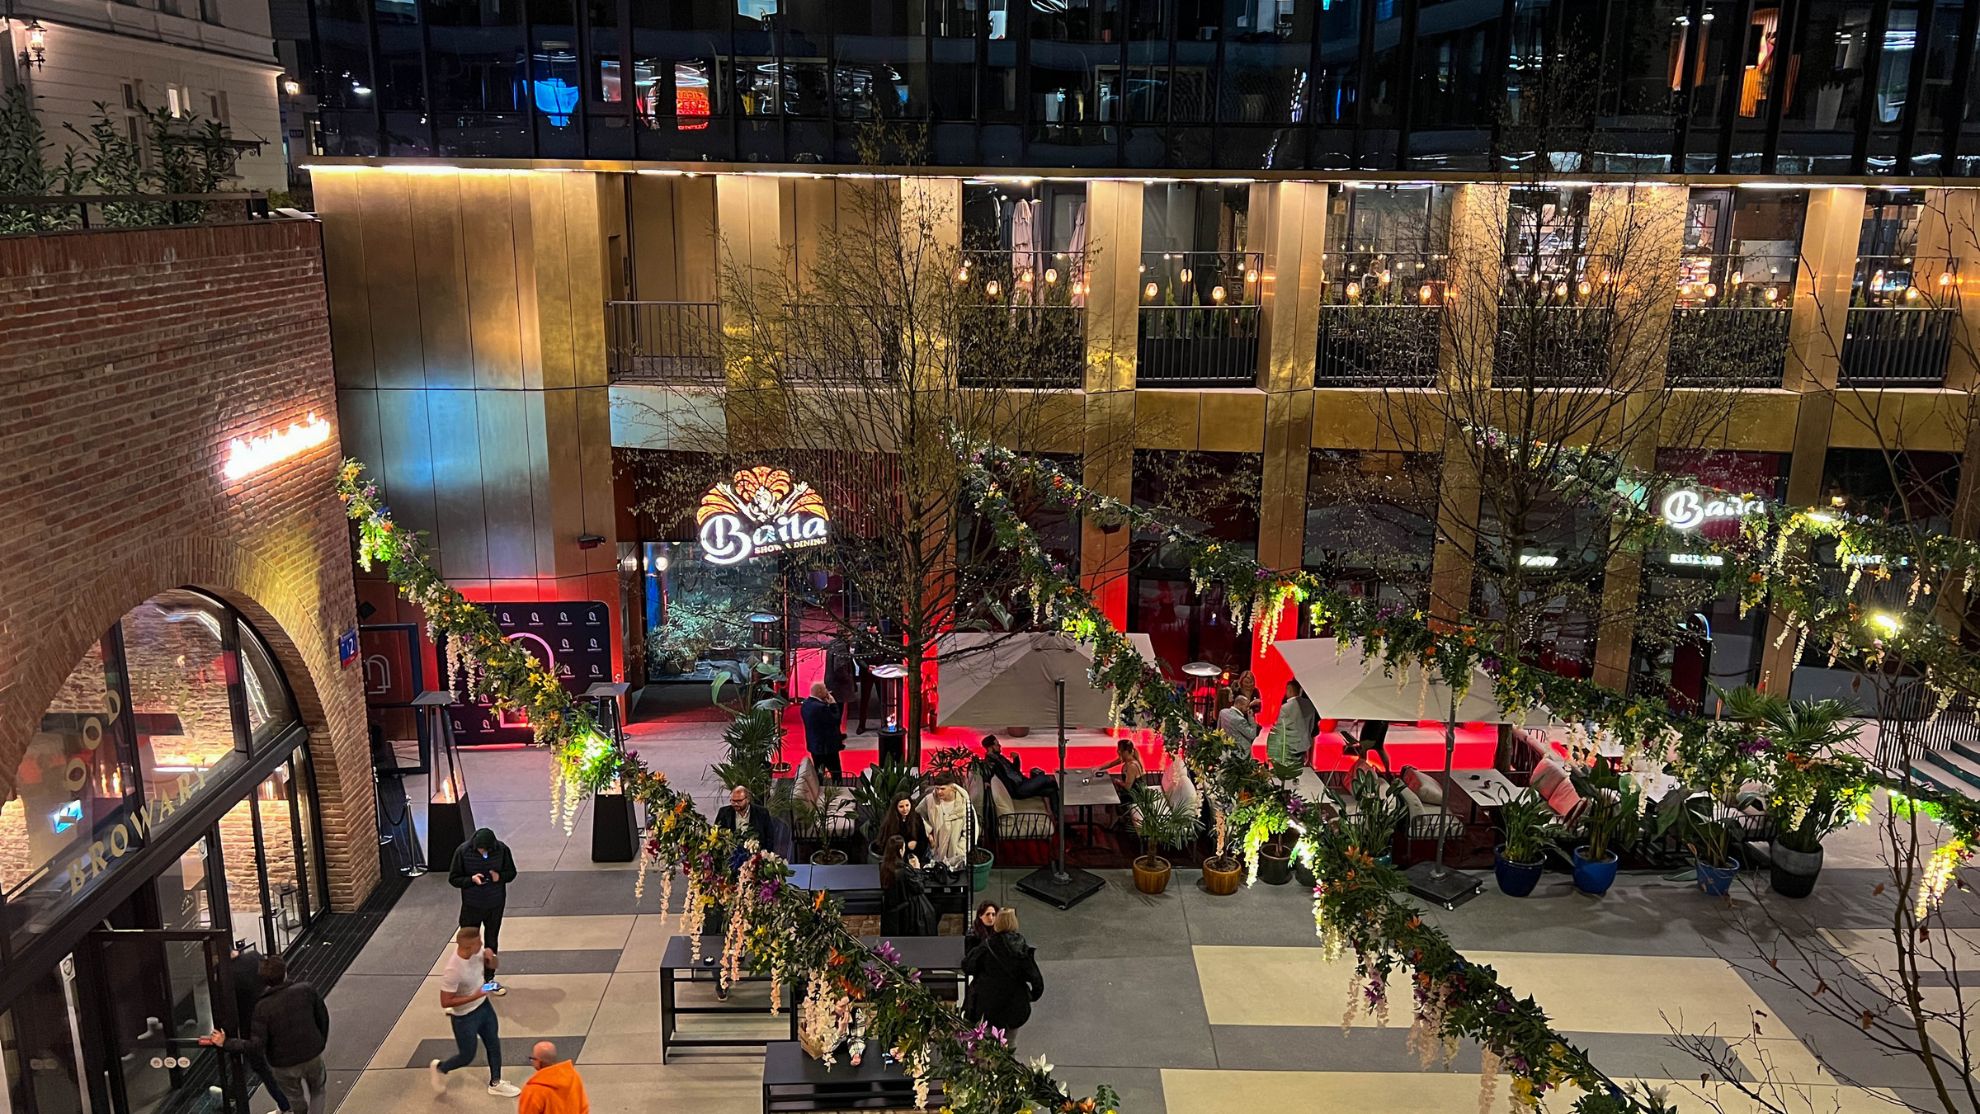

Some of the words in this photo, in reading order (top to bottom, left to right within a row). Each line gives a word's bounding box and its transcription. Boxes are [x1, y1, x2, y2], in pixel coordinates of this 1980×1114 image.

[700, 513, 828, 565] Baila
[793, 537, 828, 550] DINING
[66, 757, 206, 897] BROWARY
